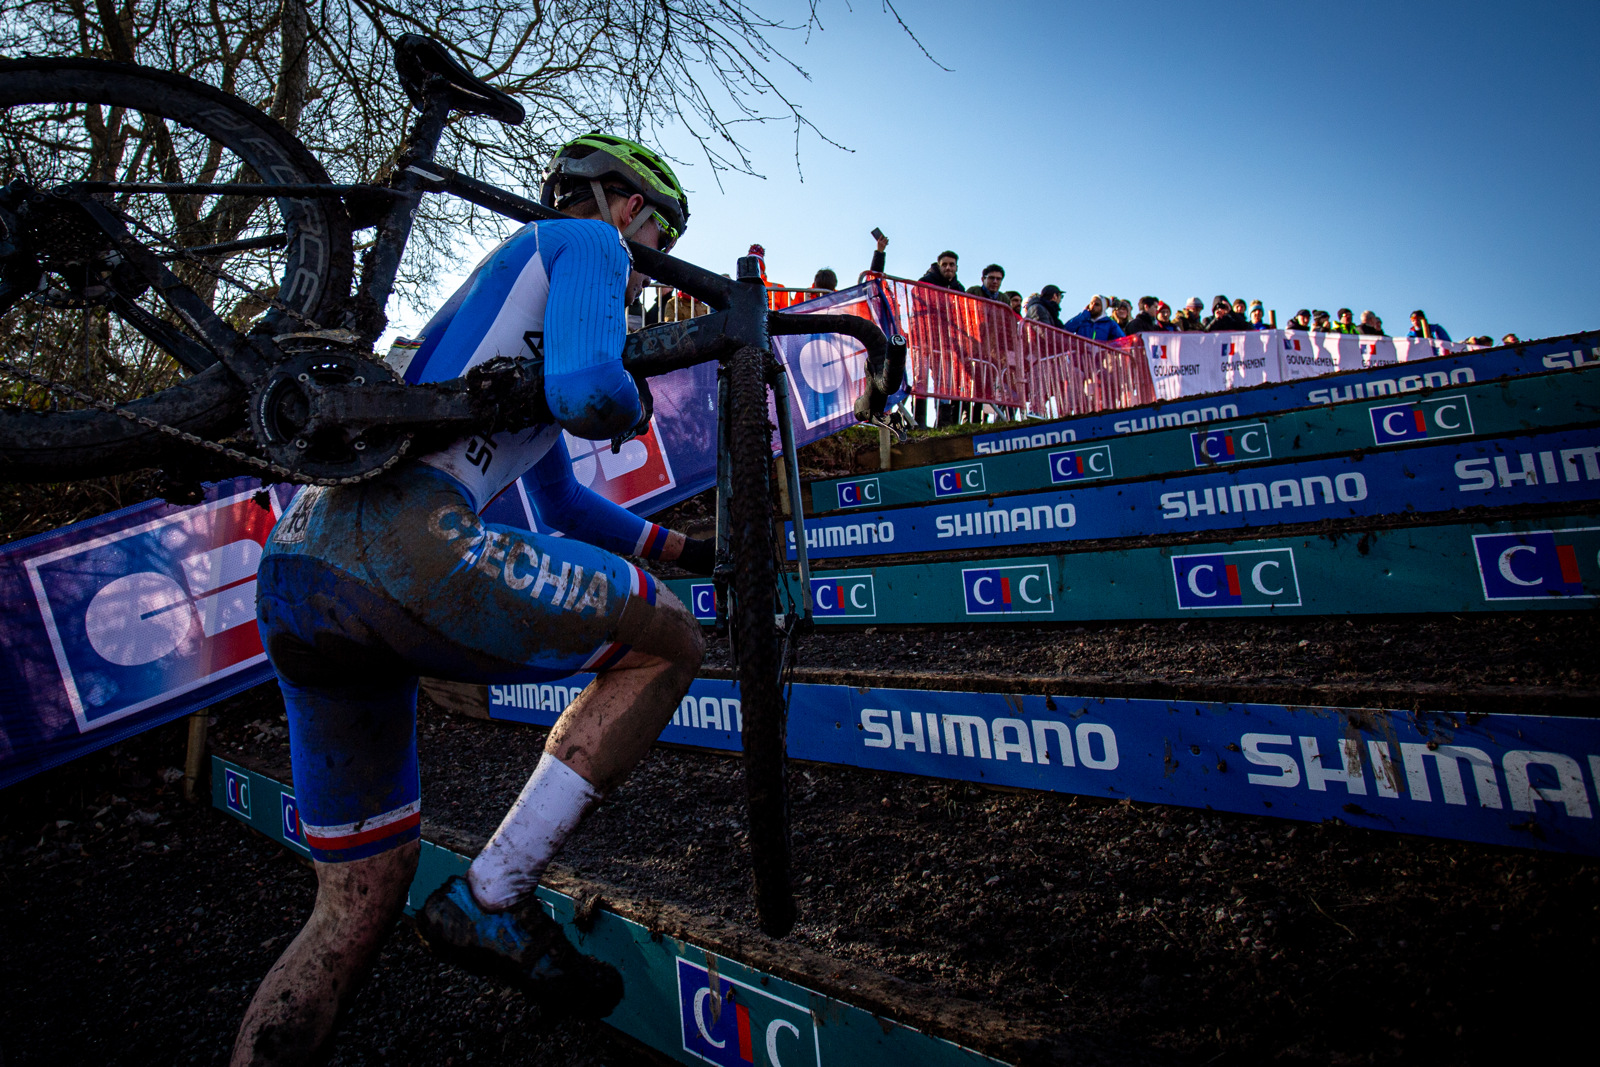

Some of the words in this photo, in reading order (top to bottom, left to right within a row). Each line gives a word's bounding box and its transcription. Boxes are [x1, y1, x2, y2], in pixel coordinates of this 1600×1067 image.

[841, 484, 876, 503] CIC
[938, 469, 980, 492] CIC
[1056, 452, 1106, 477] CIC
[1201, 431, 1261, 458] CIC
[1382, 404, 1460, 436] CIC
[935, 503, 1077, 538] SHIMANO
[1160, 471, 1368, 520] SHIMANO
[427, 503, 609, 618] CZECHIA
[816, 583, 868, 611] CIC
[973, 574, 1042, 606] CIC
[1187, 560, 1284, 598] CIC
[860, 708, 1120, 771] SHIMANO
[228, 777, 249, 810] CIC
